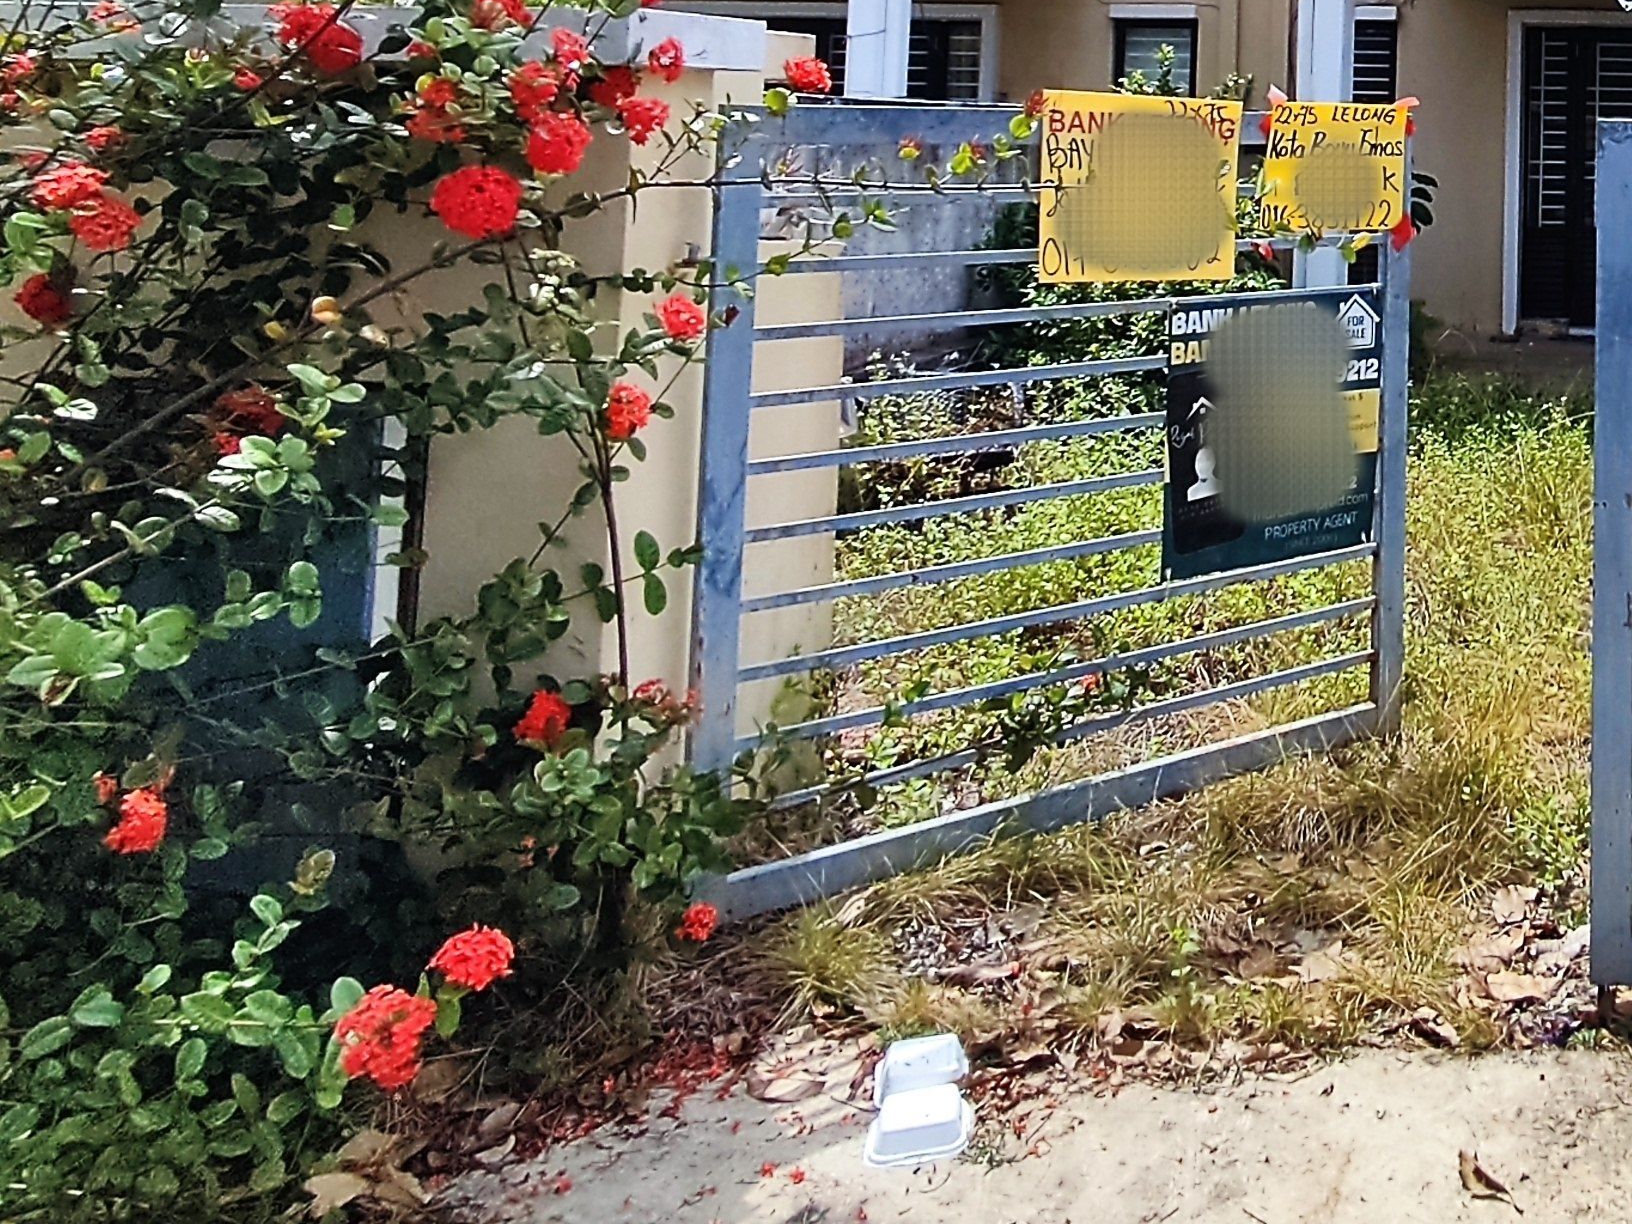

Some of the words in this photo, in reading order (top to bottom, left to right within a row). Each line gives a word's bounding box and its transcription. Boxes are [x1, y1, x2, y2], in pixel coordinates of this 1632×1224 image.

[1331, 105, 1397, 126] LELONG
[1347, 314, 1365, 327] FOR
[1264, 518, 1321, 541] PROPERTY
[1323, 511, 1358, 531] AGENT
